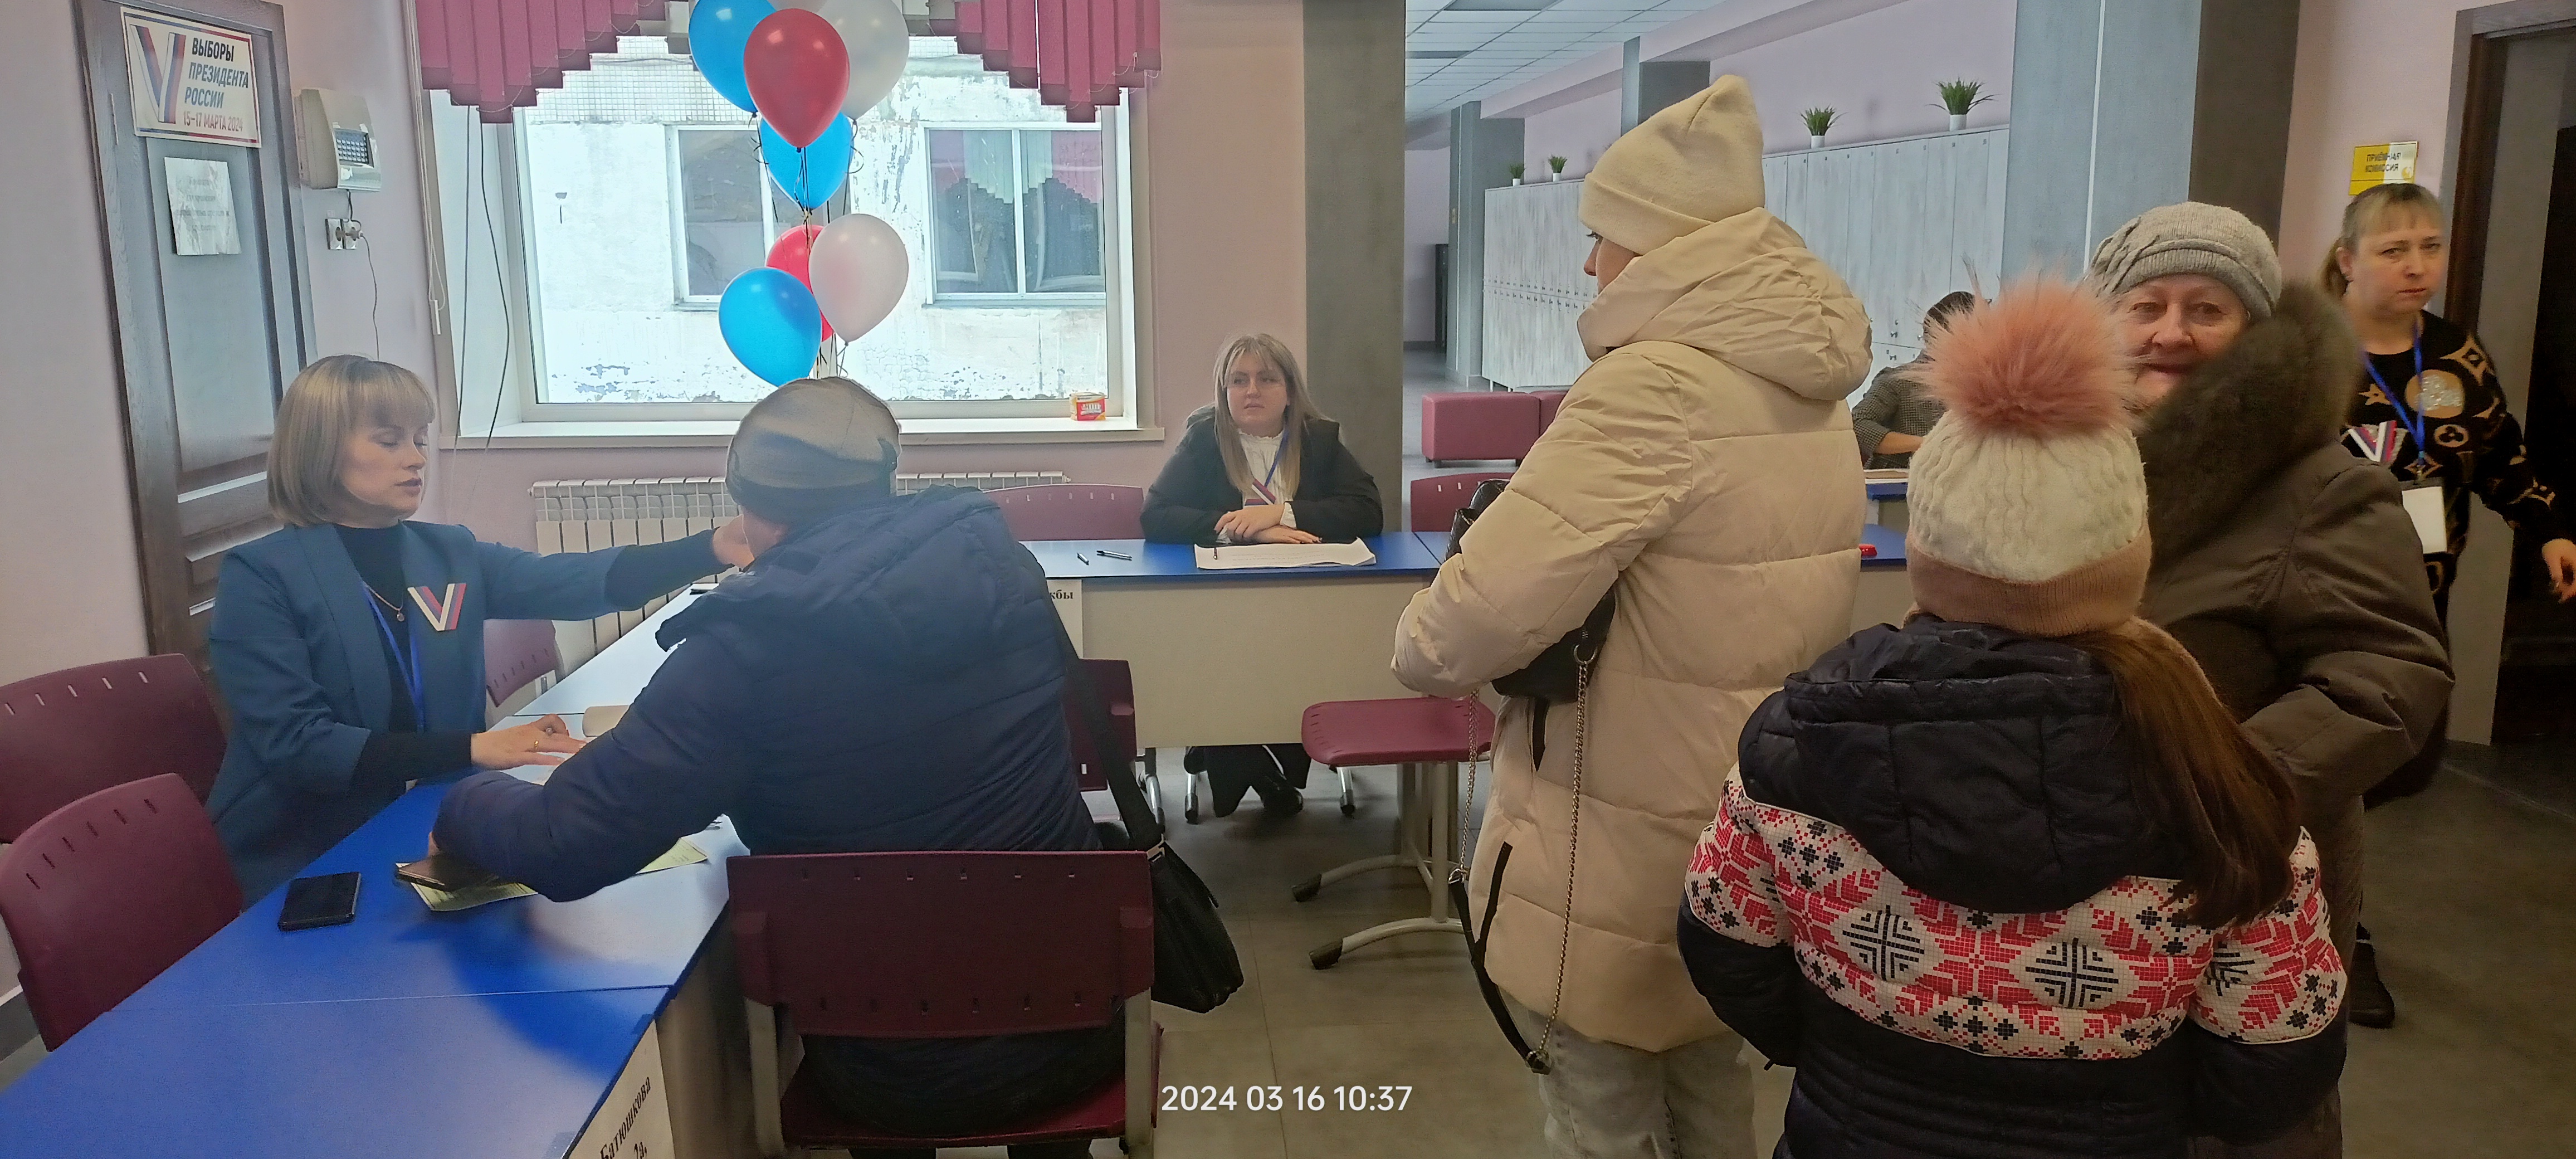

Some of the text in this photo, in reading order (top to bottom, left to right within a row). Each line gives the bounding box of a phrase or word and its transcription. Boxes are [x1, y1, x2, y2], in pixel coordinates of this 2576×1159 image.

[192, 37, 235, 62] ВЫБОРЫ
[188, 62, 248, 88] ПРЕЗИДЕНТА
[184, 86, 225, 109] РОССИИ
[203, 113, 226, 130] МАРТА
[227, 117, 243, 132] 2024
